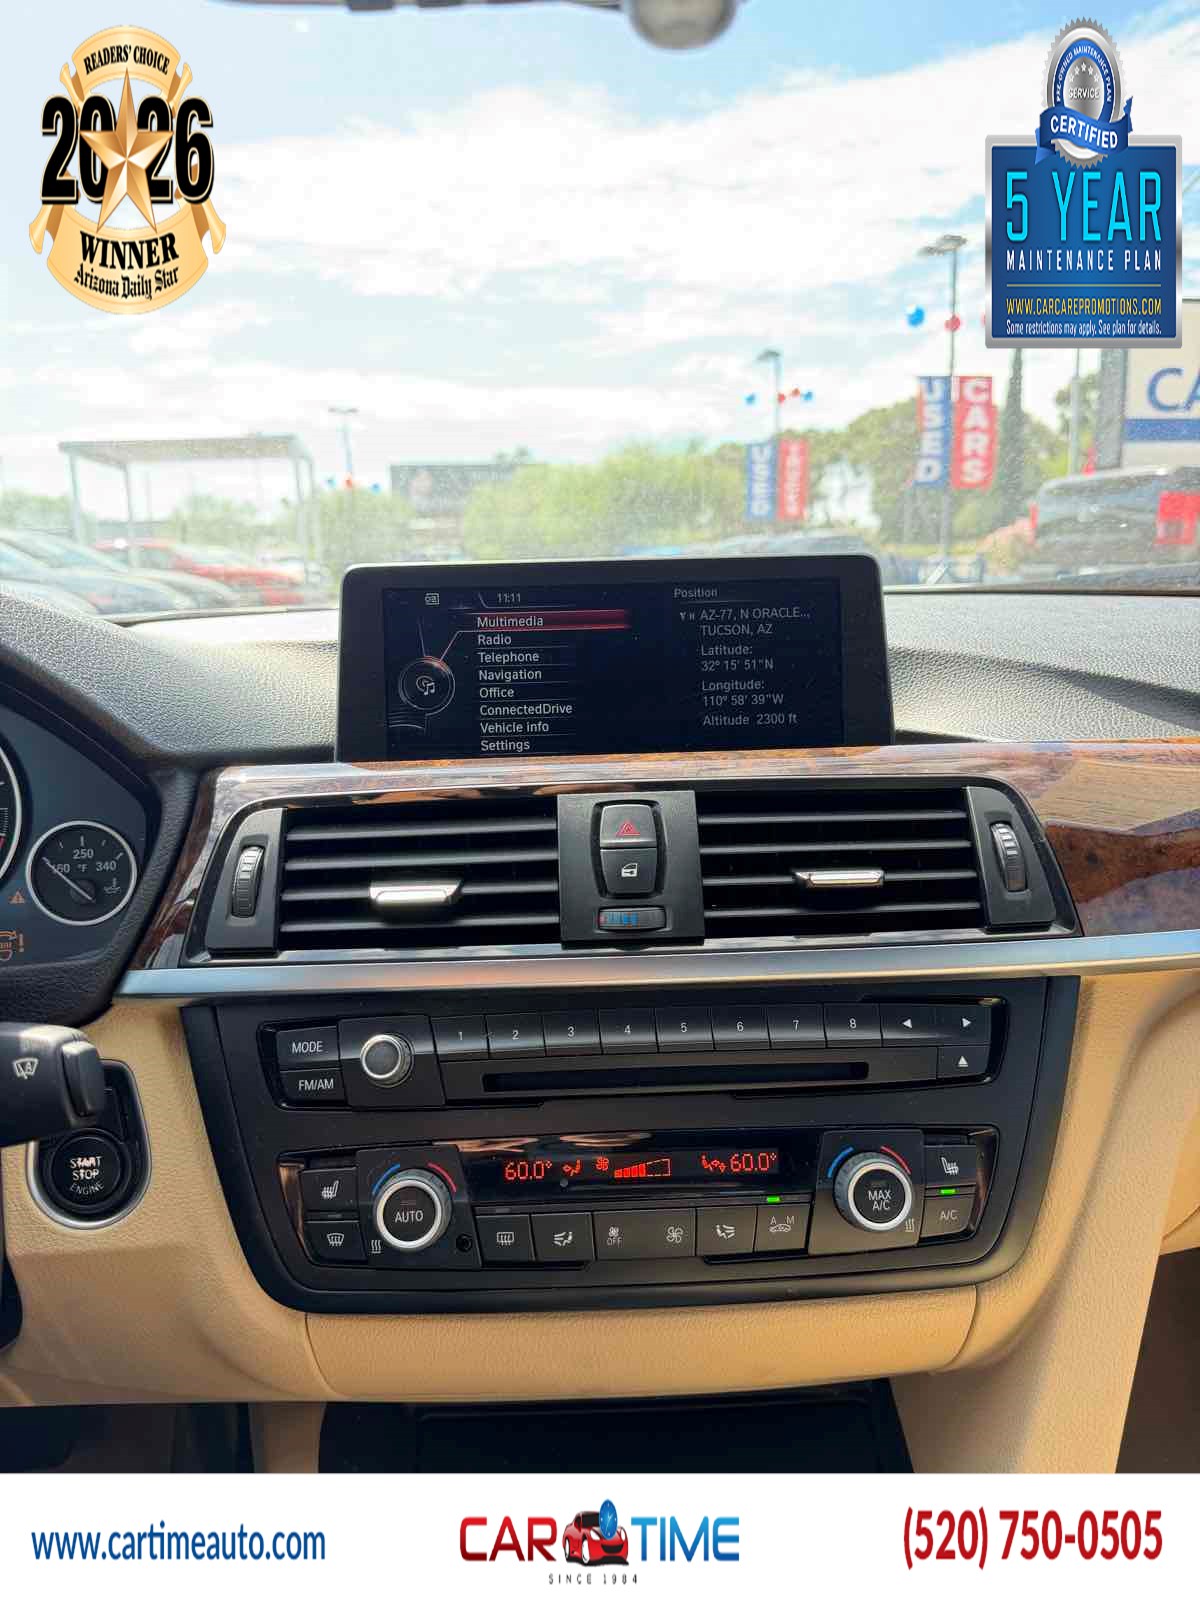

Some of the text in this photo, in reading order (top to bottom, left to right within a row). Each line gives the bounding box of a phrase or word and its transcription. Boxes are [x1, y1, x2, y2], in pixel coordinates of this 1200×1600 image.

[918, 378, 944, 484] USED
[962, 378, 990, 484] CARS
[497, 592, 521, 603] 11:11
[674, 587, 718, 599] Position
[700, 609, 737, 621] AZ-77,
[740, 608, 750, 619] N
[477, 615, 544, 628] Multimedia
[701, 623, 774, 636] TUCSON, AZ
[477, 634, 512, 646] Radio
[701, 644, 753, 656] Latitude:
[479, 651, 540, 665] Telephone
[479, 668, 542, 682] Navigation
[479, 686, 515, 698] Office
[702, 679, 765, 693] Longitude:
[479, 703, 573, 716] ConnectedDrive
[703, 713, 798, 726] Altitude 2300 ft
[480, 720, 549, 734] Vehicle info
[480, 738, 531, 752] Settings
[73, 849, 94, 860] 250
[96, 861, 117, 873] 340
[457, 1017, 857, 1041] 1 2 3 4 5 6 7 8
[292, 1040, 323, 1053] MODE
[298, 1077, 334, 1092] FM/AM
[70, 1156, 101, 1169] START
[730, 1152, 777, 1173] 60.0°
[72, 1168, 100, 1181] STOP
[504, 1160, 553, 1181] 60.0°
[70, 1182, 105, 1195] ENGINE
[868, 1190, 891, 1201] MAX
[871, 1200, 890, 1211] A/C
[395, 1210, 424, 1224] AUTO
[770, 1216, 795, 1225] A M
[940, 1210, 958, 1222] A/C
[607, 1237, 623, 1247] OFF
